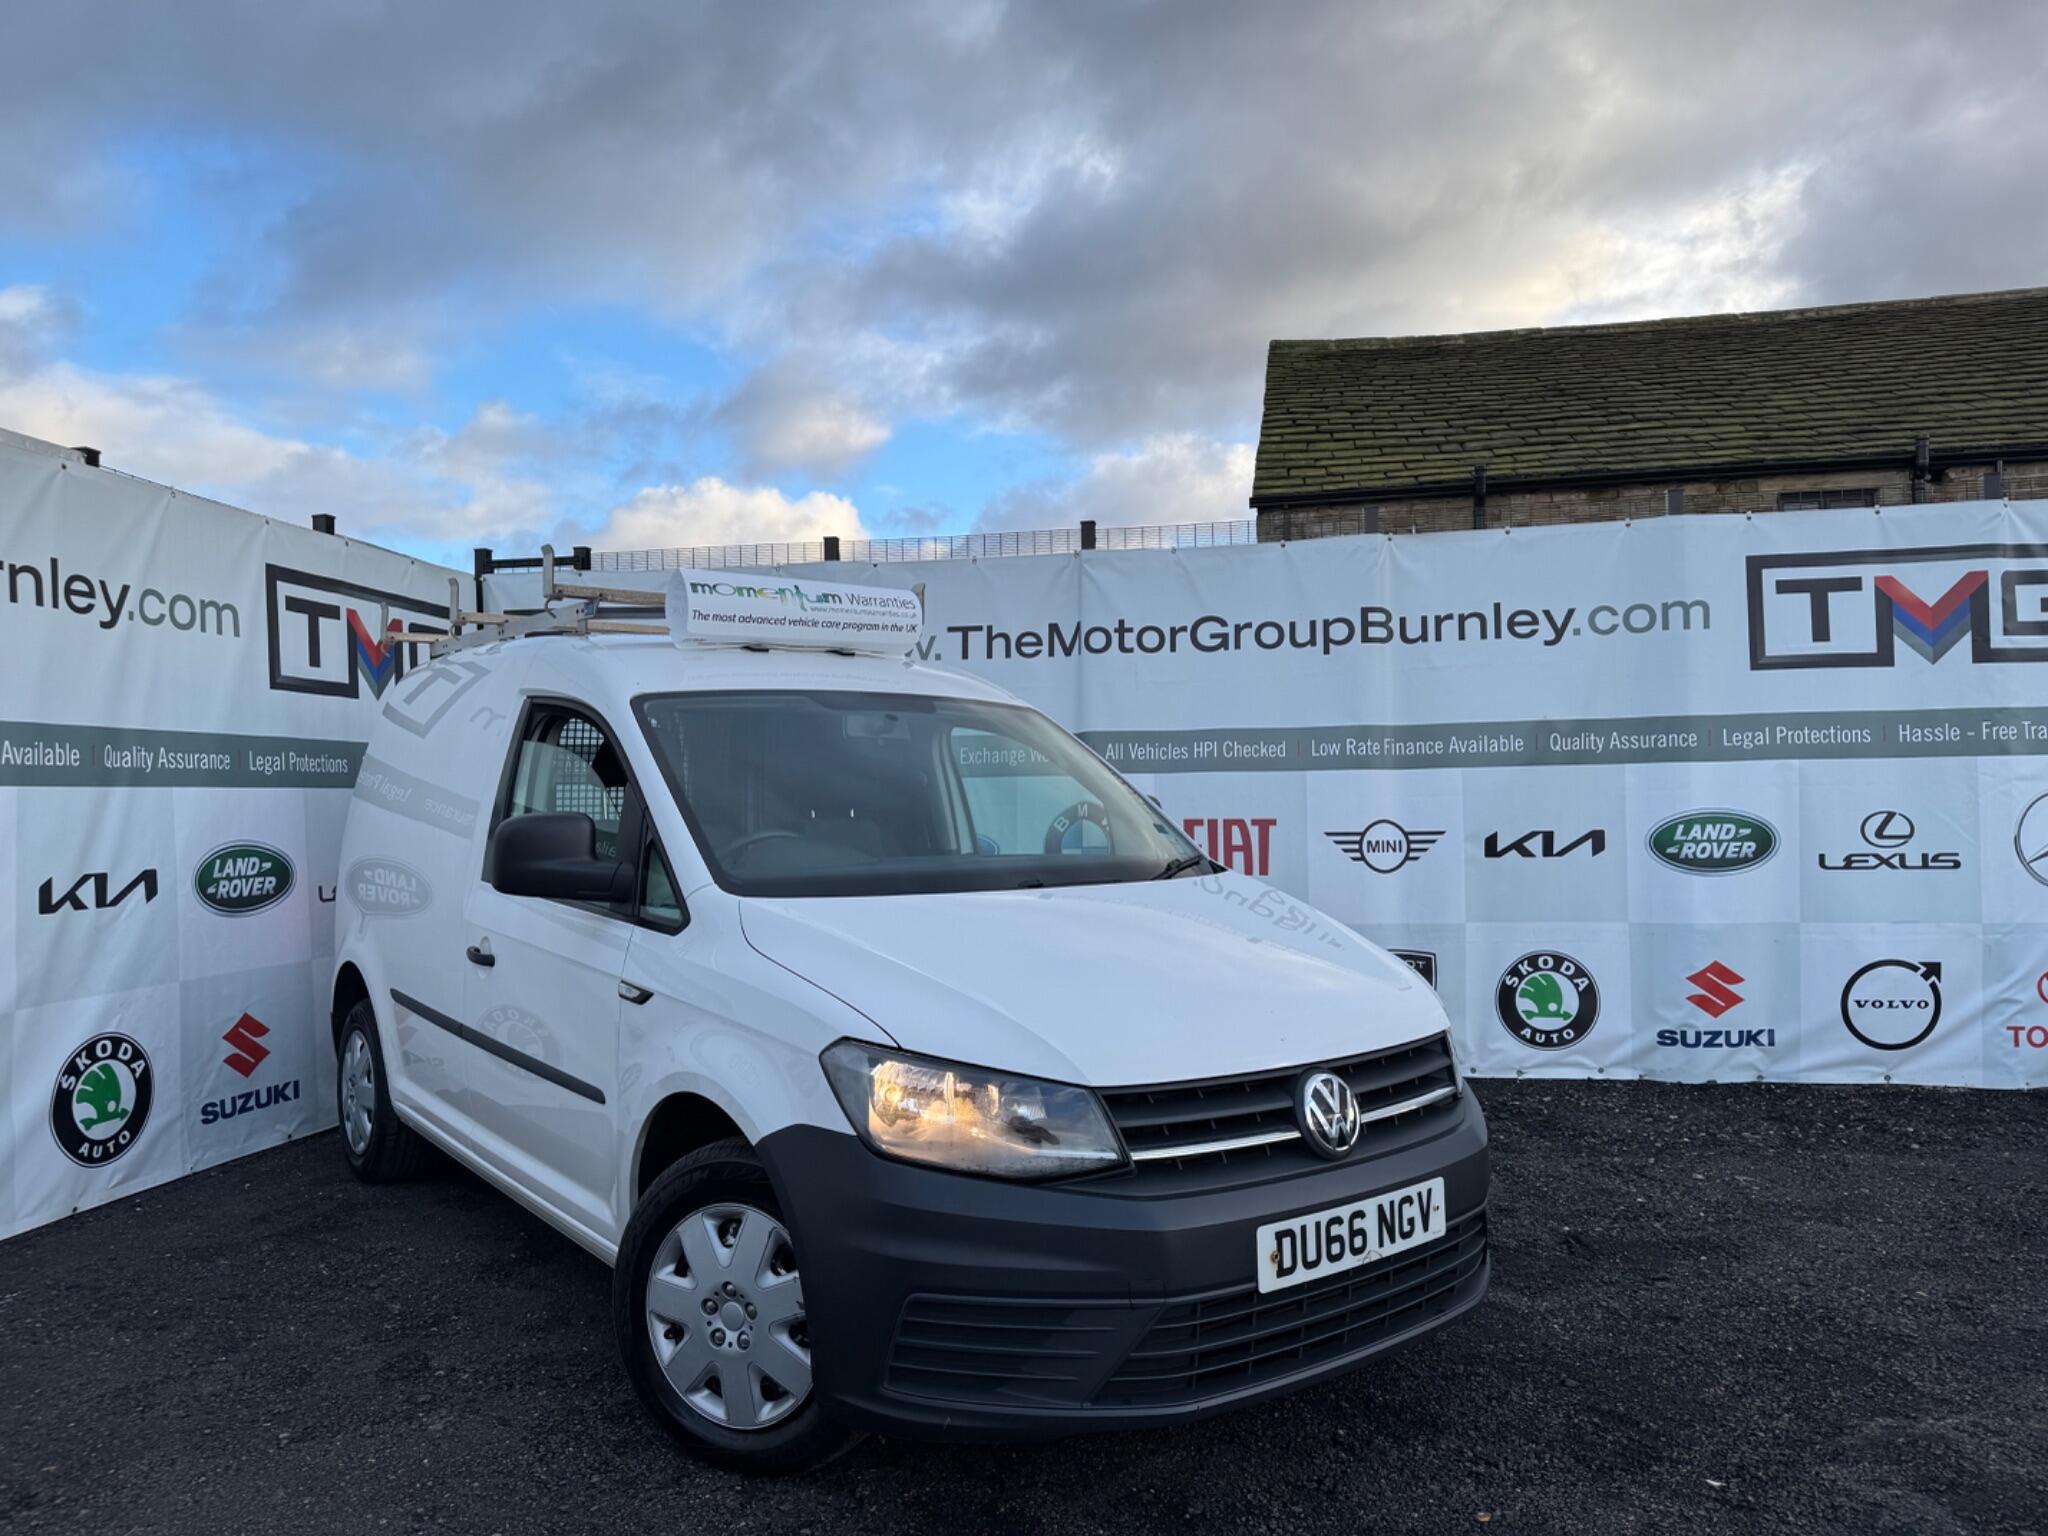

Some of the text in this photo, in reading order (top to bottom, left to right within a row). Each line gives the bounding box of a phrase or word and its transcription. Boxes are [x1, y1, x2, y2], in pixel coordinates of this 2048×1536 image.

[0, 556, 241, 637] nley.com
[690, 582, 916, 612] momentum Warranties
[692, 609, 918, 634] The most advanced vehicle care program in the UK
[1105, 743, 1124, 761] All
[1128, 742, 1189, 761] Vehicles
[1194, 741, 1217, 759] HPI
[1223, 740, 1286, 759] Checked
[1311, 739, 1341, 757] Low
[1346, 737, 1381, 756] Rate
[1383, 737, 1444, 756] Finance
[1449, 734, 1524, 754] Available
[1550, 731, 1604, 754] Quality
[1609, 730, 1698, 750] Assurance
[1722, 726, 1769, 749] Legal
[1776, 724, 1872, 745] Protections
[1898, 722, 1961, 743] Hassle
[1982, 720, 2018, 741] Free
[1, 740, 349, 776] Available Quality Assurance Legal Protections
[959, 746, 1026, 768] Exchange
[1483, 829, 1606, 858] KIA
[1673, 823, 1736, 842] LAND
[1366, 839, 1403, 854] MINI
[1680, 841, 1757, 861] ROVER
[213, 856, 260, 879] LAND
[1818, 852, 1961, 871] LEXUS
[38, 867, 159, 916] KIA
[216, 875, 277, 900] ROVER
[1854, 999, 1930, 1010] VOLVO
[1520, 1027, 1575, 1044] AUTO
[1655, 1027, 1776, 1050] SUZUKI
[201, 1079, 300, 1125] SUZUKI
[78, 1129, 132, 1158] AUTO
[1274, 1187, 1433, 1280] DU66 NGV
